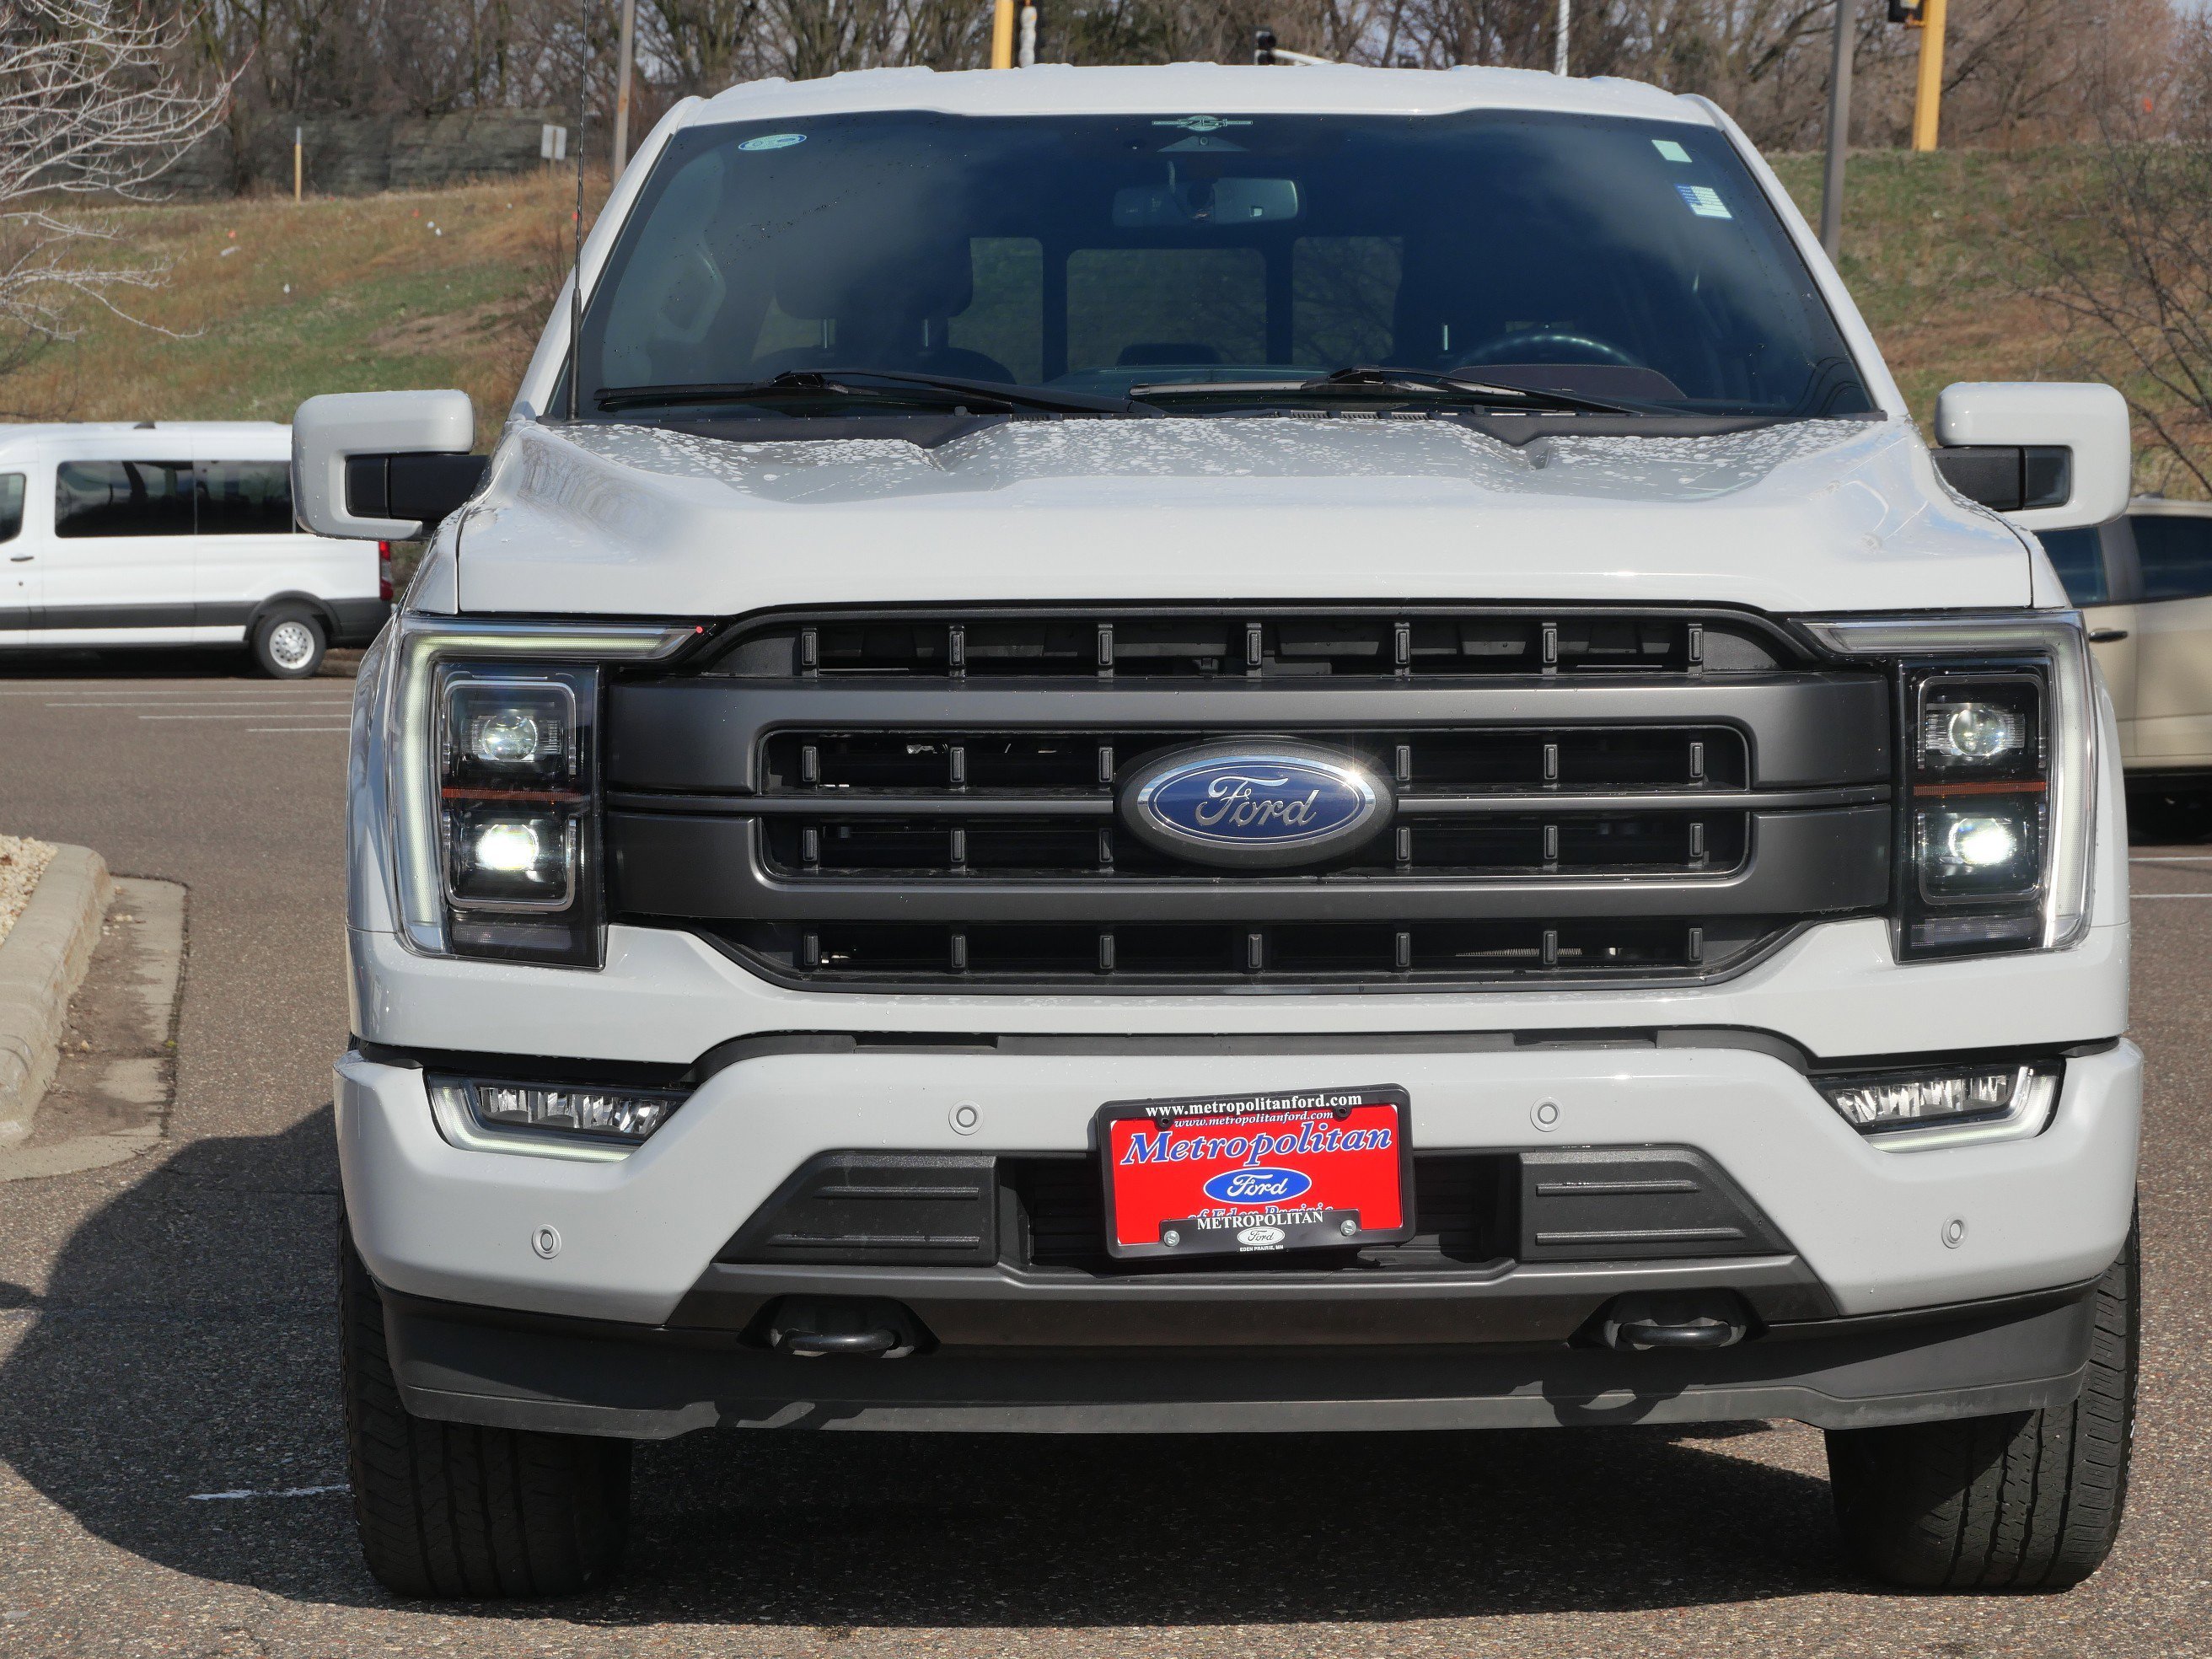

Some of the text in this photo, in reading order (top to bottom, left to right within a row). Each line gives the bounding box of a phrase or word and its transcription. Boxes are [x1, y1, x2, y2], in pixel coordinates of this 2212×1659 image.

[1195, 776, 1320, 826] Ford
[1146, 1094, 1362, 1118] www.metropolitanford.com
[1174, 1111, 1334, 1128] www.metropolitanford.com
[1119, 1121, 1393, 1167] Metropolitan
[1227, 1173, 1288, 1197] Ford
[1197, 1211, 1323, 1230] METROPOLITAN
[1248, 1230, 1275, 1242] Ford
